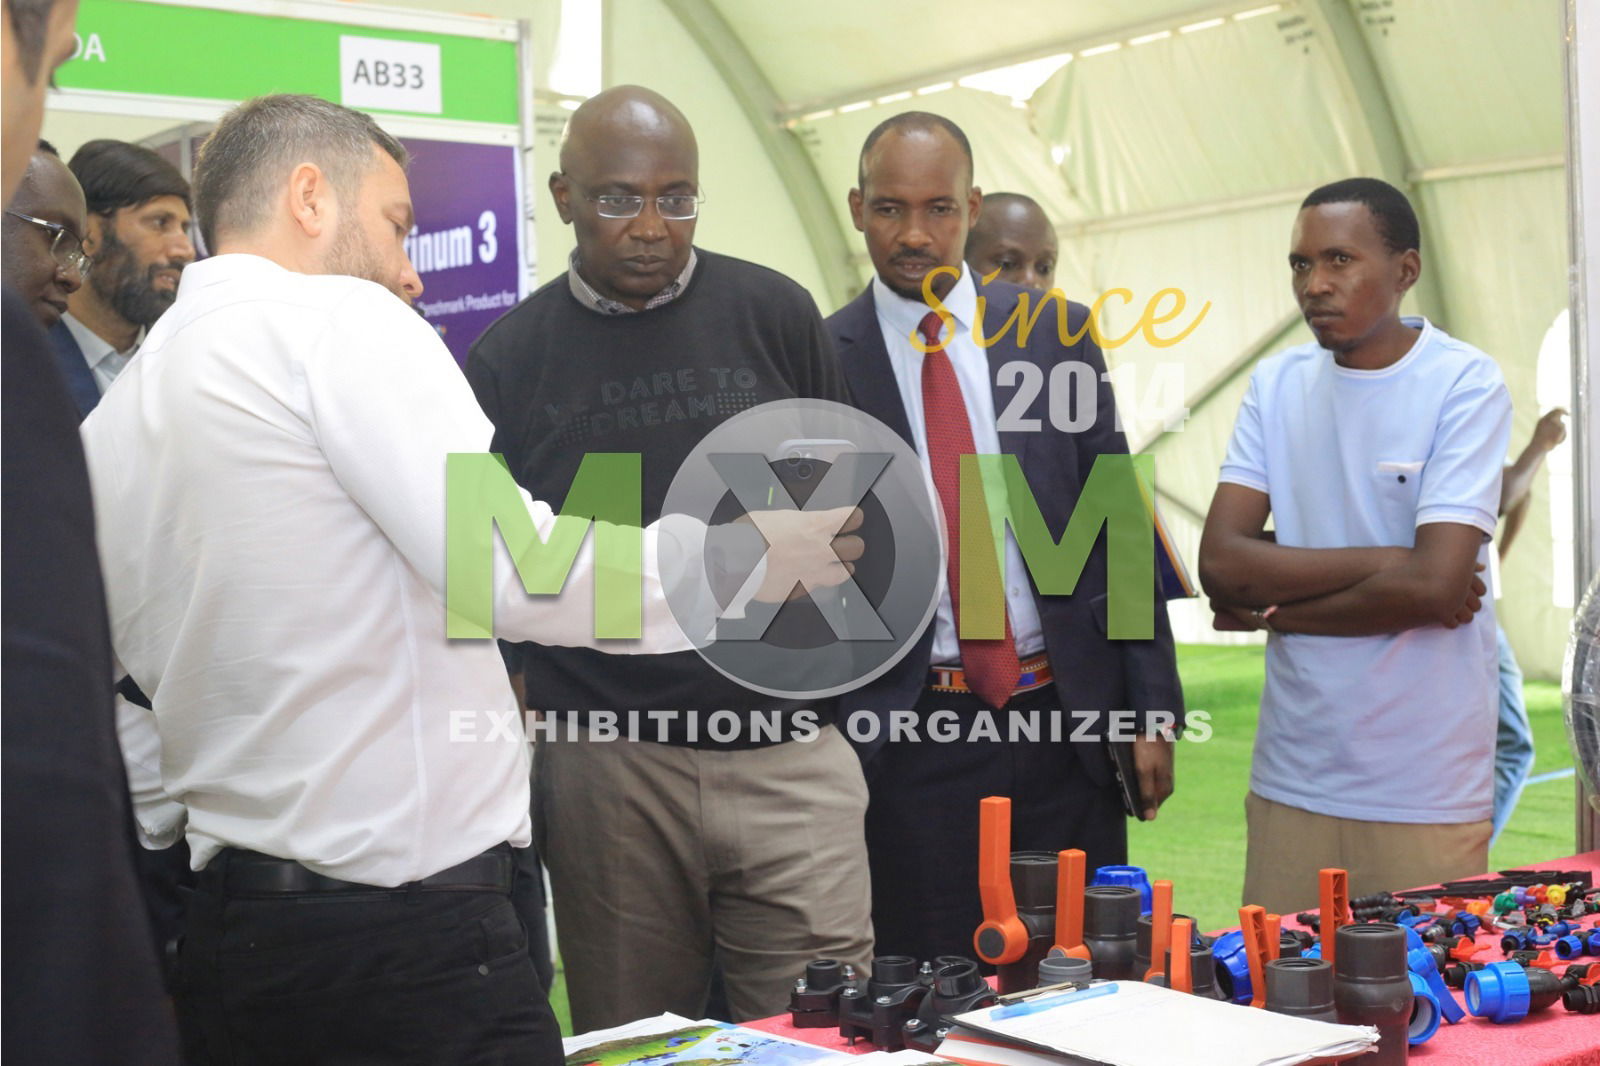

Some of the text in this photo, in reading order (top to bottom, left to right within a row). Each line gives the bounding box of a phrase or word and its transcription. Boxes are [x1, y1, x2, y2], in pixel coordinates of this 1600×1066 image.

[352, 58, 425, 90] AB33
[477, 209, 499, 264] 3
[600, 368, 698, 405] DARE
[710, 366, 758, 389] TO
[590, 393, 718, 437] DREAM
